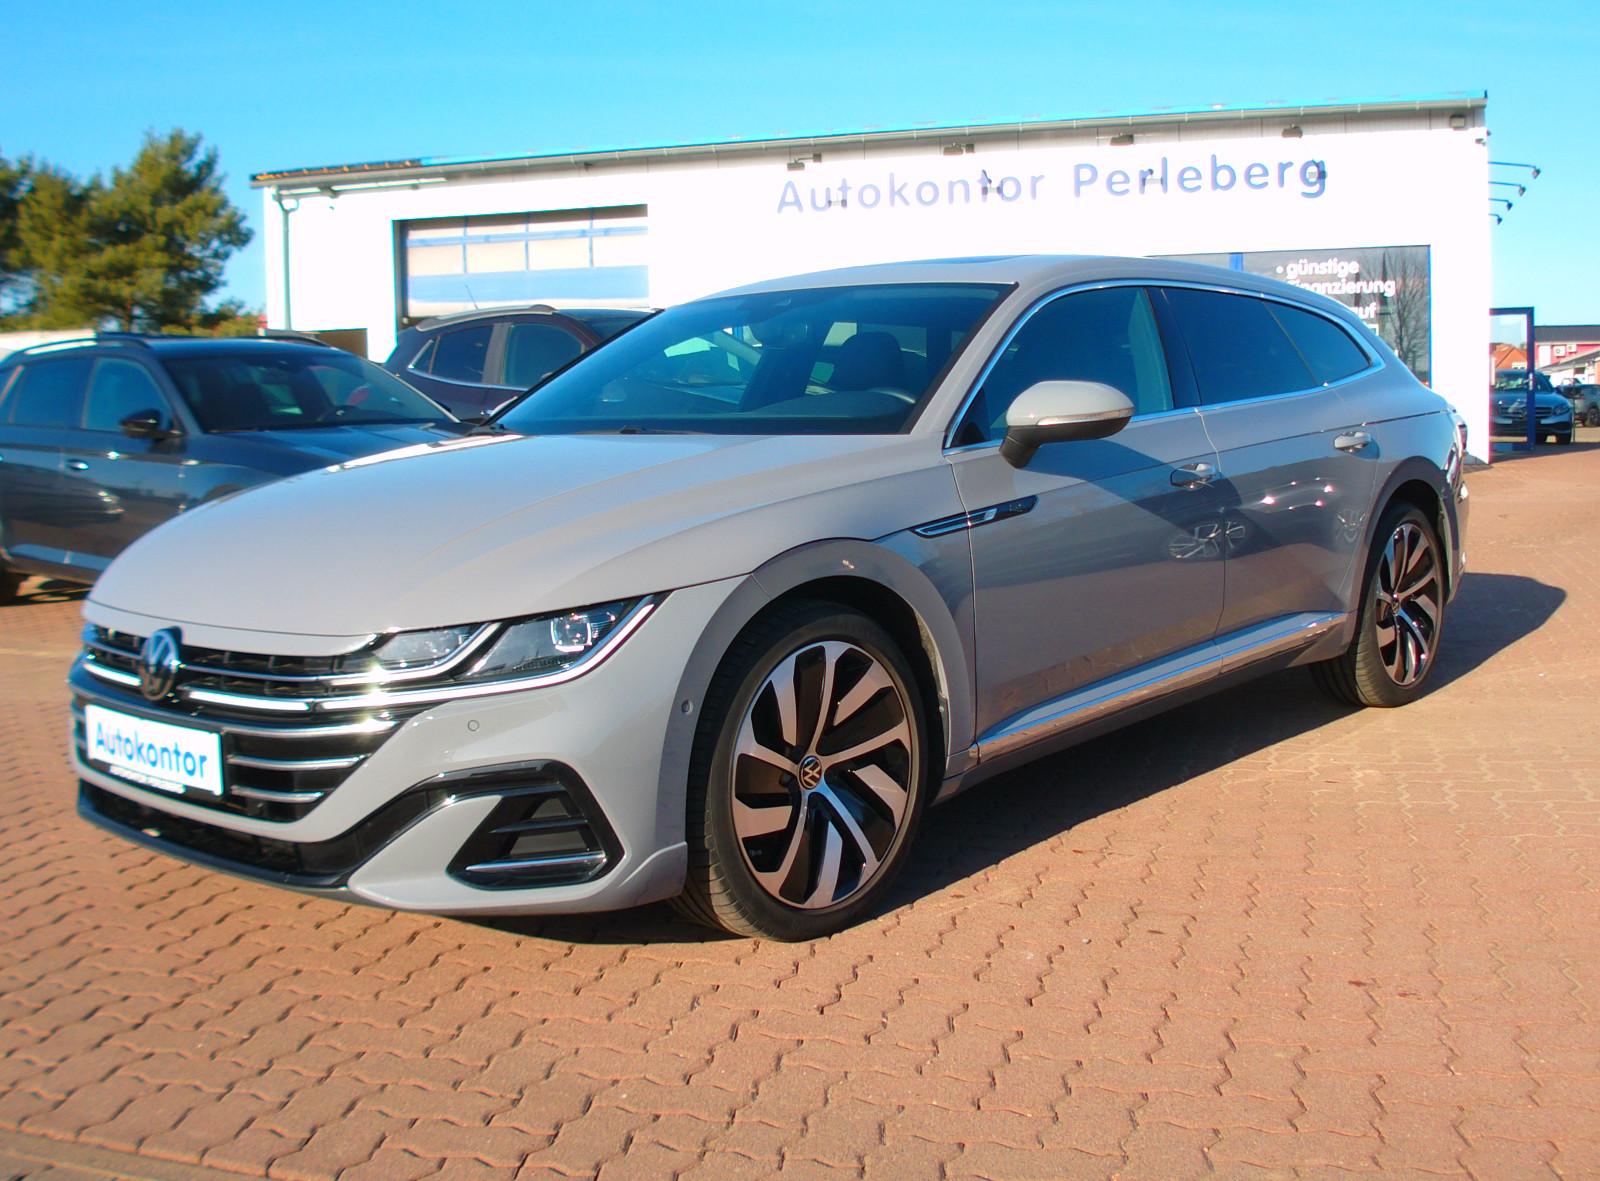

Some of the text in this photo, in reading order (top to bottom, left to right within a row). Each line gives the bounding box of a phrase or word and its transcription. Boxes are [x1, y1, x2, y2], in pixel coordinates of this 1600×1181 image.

[776, 153, 1328, 214] Autokontor Perleberg
[1286, 257, 1360, 279] günstige
[96, 722, 207, 778] Autokontor
